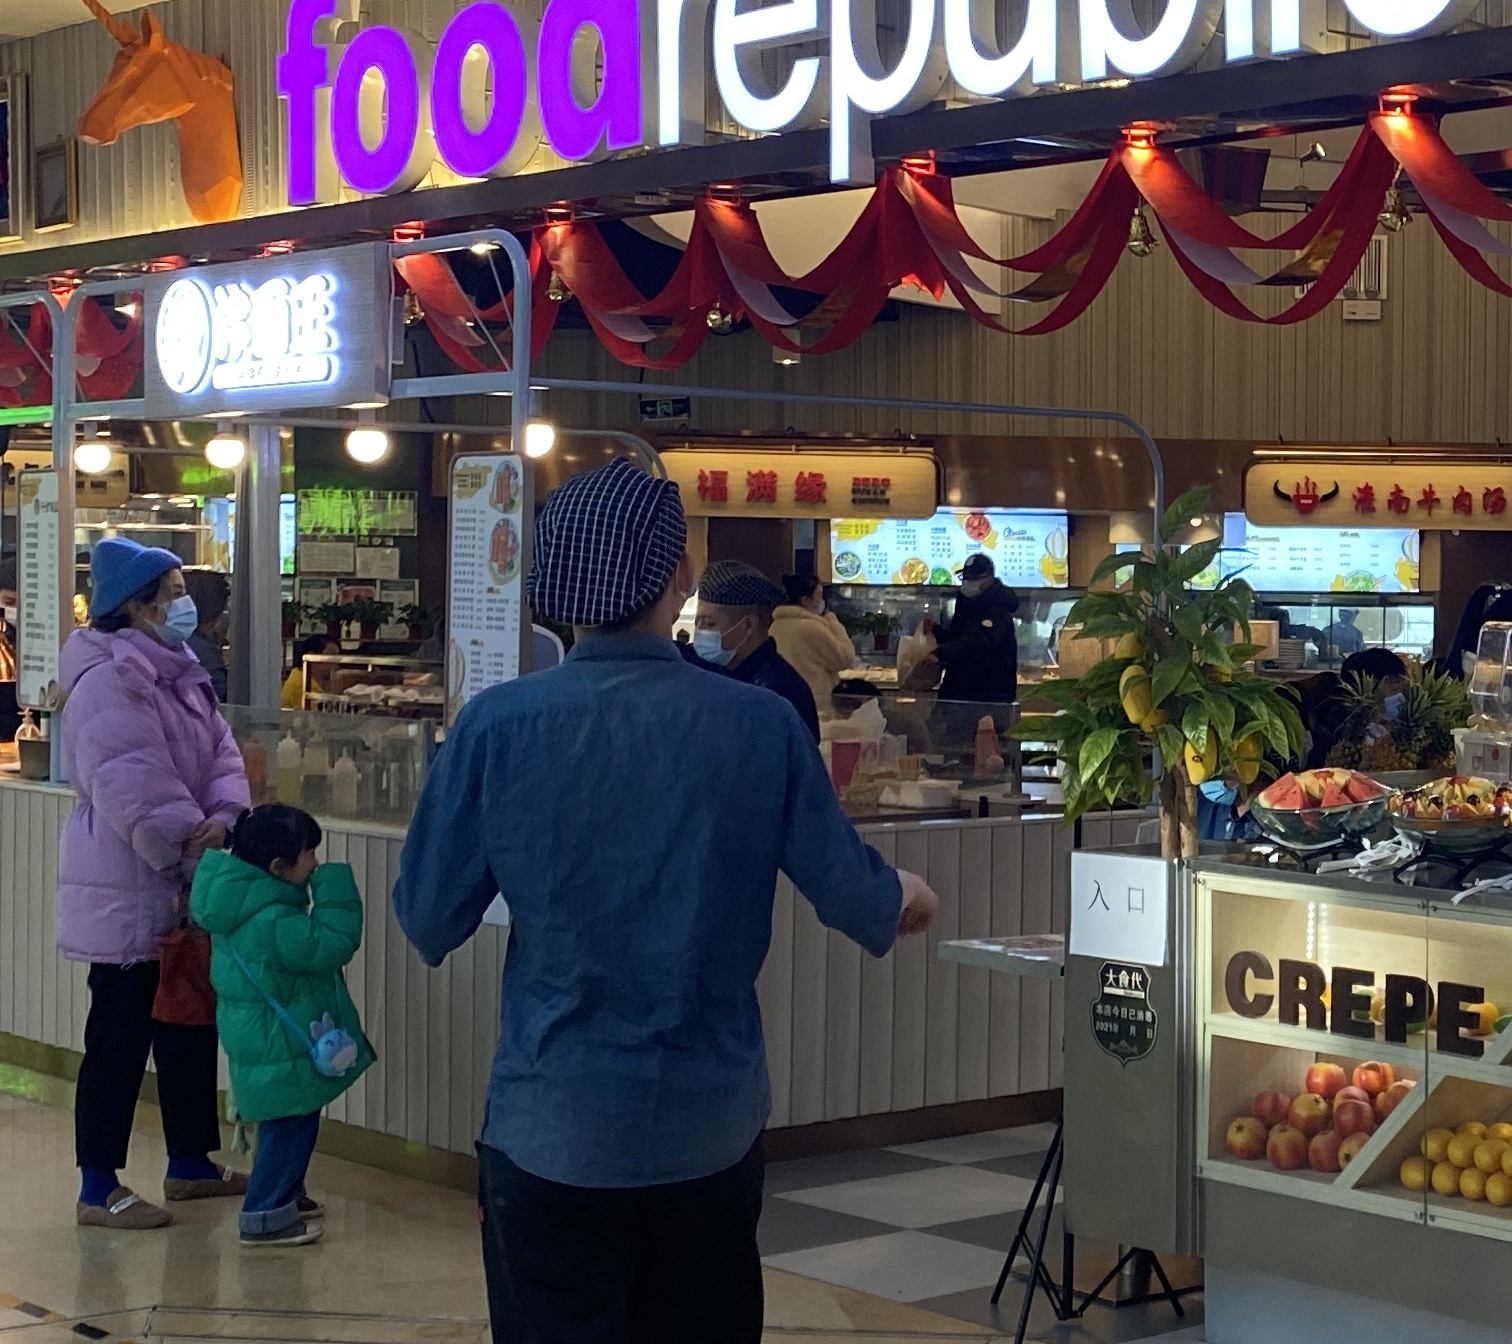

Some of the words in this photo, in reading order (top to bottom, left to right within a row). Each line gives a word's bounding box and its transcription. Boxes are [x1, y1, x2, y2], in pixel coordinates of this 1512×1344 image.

[697, 469, 827, 503] 福满缘
[1352, 482, 1507, 517] 淮南牛肉汤
[1088, 879, 1144, 913] 入口
[1105, 968, 1143, 991] 大食代
[1095, 1005, 1153, 1023] 本店今日已消毒
[1224, 951, 1486, 1057] CREPE
[1095, 1020, 1119, 1033] 2021年
